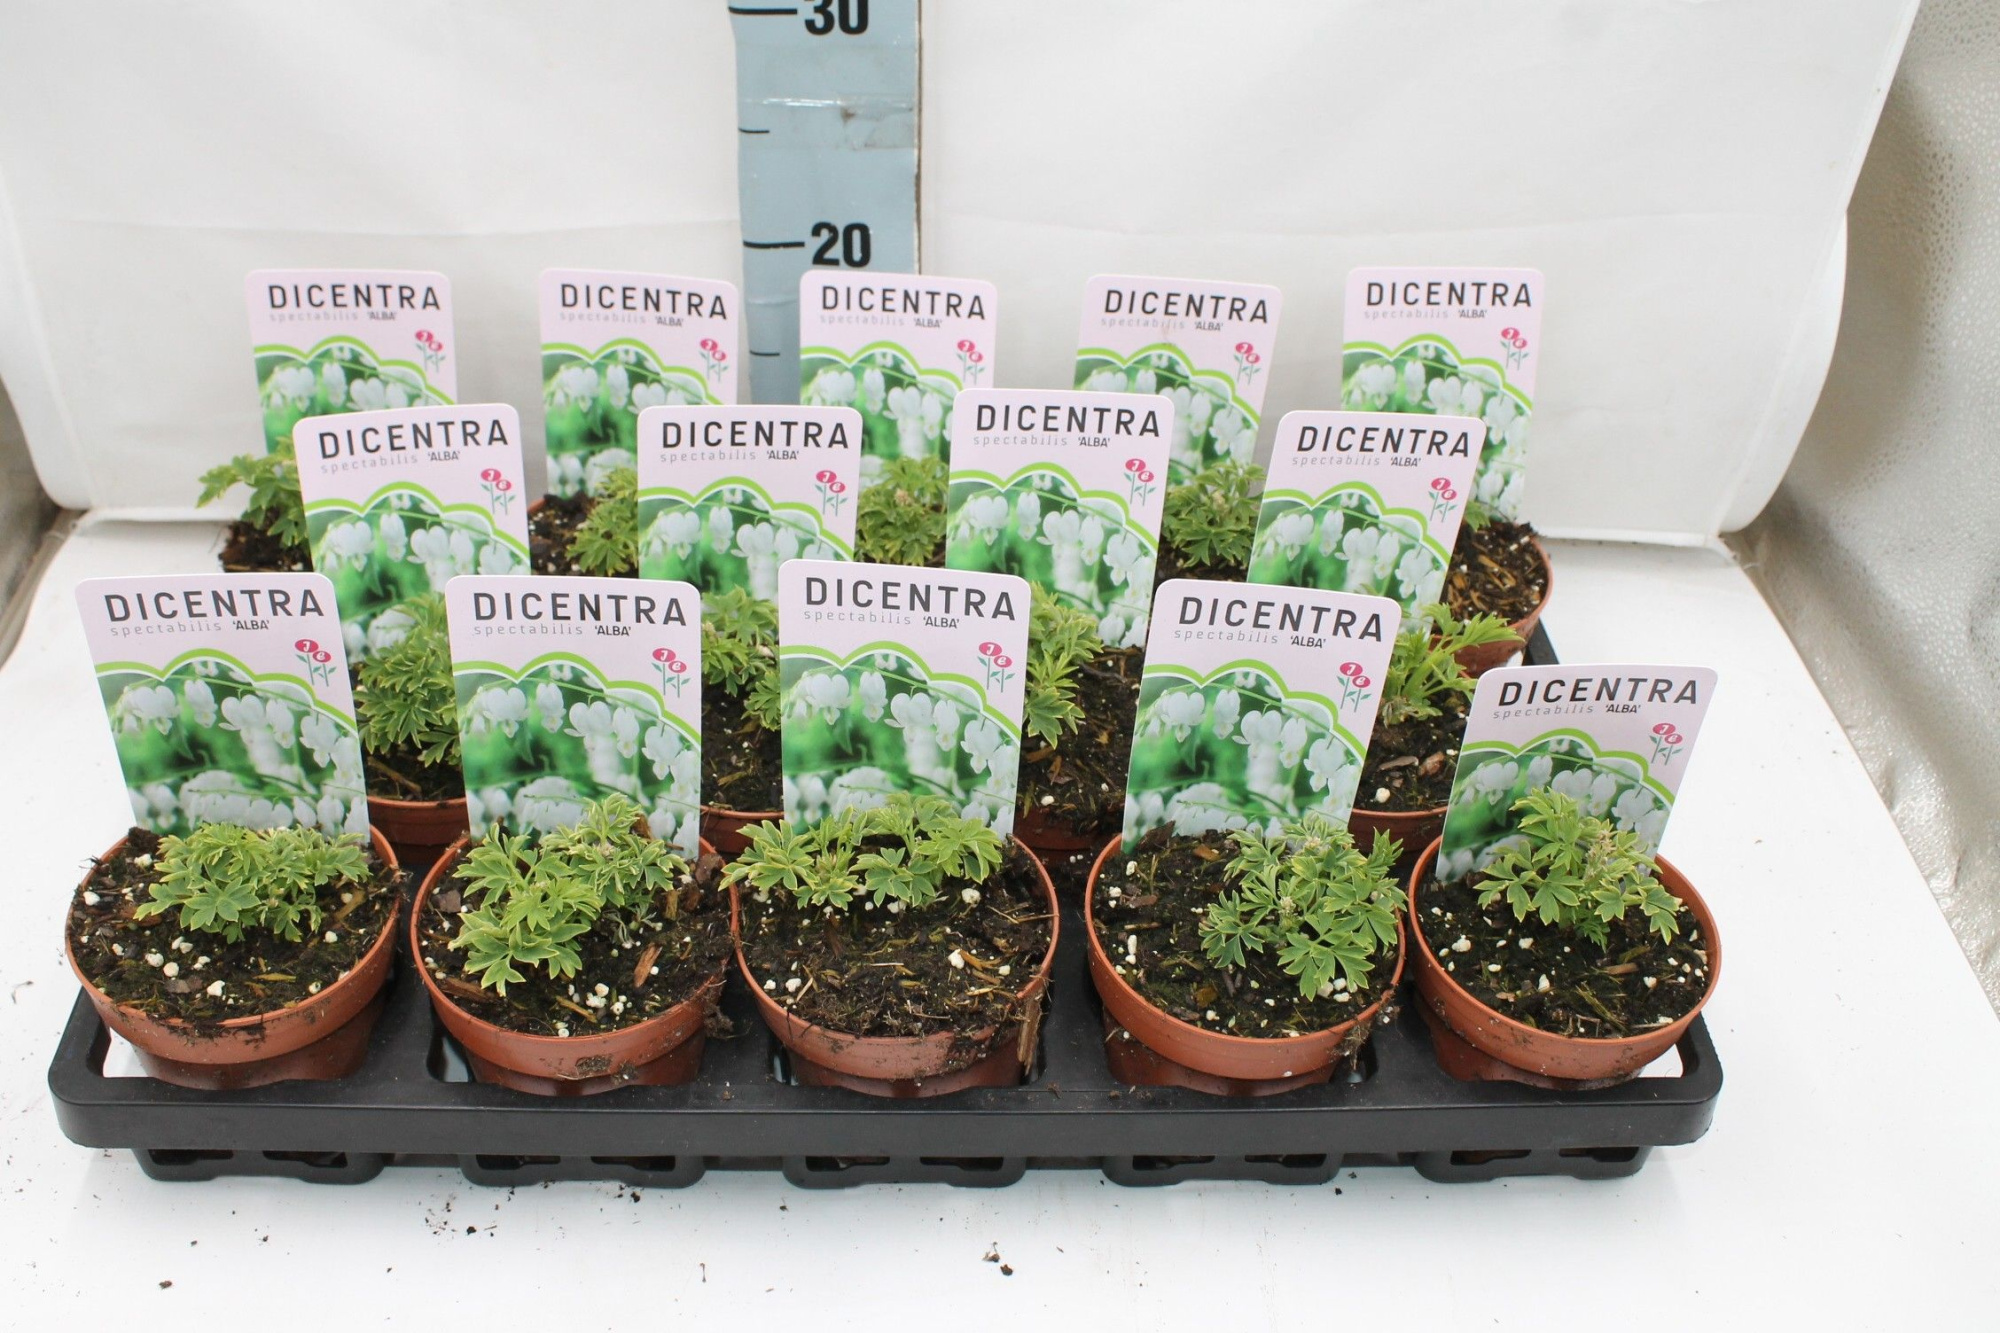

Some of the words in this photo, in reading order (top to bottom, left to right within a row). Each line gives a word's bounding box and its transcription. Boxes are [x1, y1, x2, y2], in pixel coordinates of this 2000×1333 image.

[805, 0, 868, 35] 30
[811, 221, 871, 267] 20
[269, 285, 440, 310] DICENTRA
[561, 284, 727, 319] DICENTRA
[821, 286, 985, 320] DICENTRA
[1105, 290, 1269, 324] DICENTRA
[1367, 281, 1532, 308] DICENTRA
[366, 311, 397, 320] 'ALBA'
[655, 316, 684, 327] 'ALBA'
[913, 316, 943, 329] 'ALBA'
[1193, 319, 1224, 332] 'ALBA'
[1458, 307, 1488, 319] 'ALBA'
[977, 405, 1159, 437] DICENTRA
[319, 420, 508, 459] DICENTRA
[663, 422, 848, 448] DICENTRA
[973, 435, 1069, 446] spectabilis
[1077, 436, 1110, 448] 'ALBA'
[1297, 426, 1469, 457] DICENTRA
[321, 454, 418, 474] spectabilis
[427, 450, 460, 462] 'ALBA'
[660, 450, 758, 462] spectabilis
[766, 448, 800, 461] 'ALBA'
[1292, 454, 1381, 466] spectabilis
[1389, 455, 1421, 468] 'ALBA'
[105, 589, 324, 622] DICENTRA
[474, 592, 687, 626] DICENTRA
[806, 578, 1016, 620] DICENTRA
[110, 621, 222, 638] spectabilis
[232, 619, 271, 632] 'ALBA'
[473, 623, 583, 635] spectabilis
[594, 624, 632, 636] 'ALBA'
[803, 609, 912, 624] spectabilis
[922, 615, 960, 629] 'ALBA'
[1179, 597, 1384, 642] DICENTRA
[1173, 627, 1278, 644] spectabilis
[1290, 635, 1327, 649] 'ALBA'
[1499, 678, 1697, 705] DICENTRA
[1493, 705, 1594, 719] spectabilis
[1605, 704, 1642, 714] 'ALBA'
